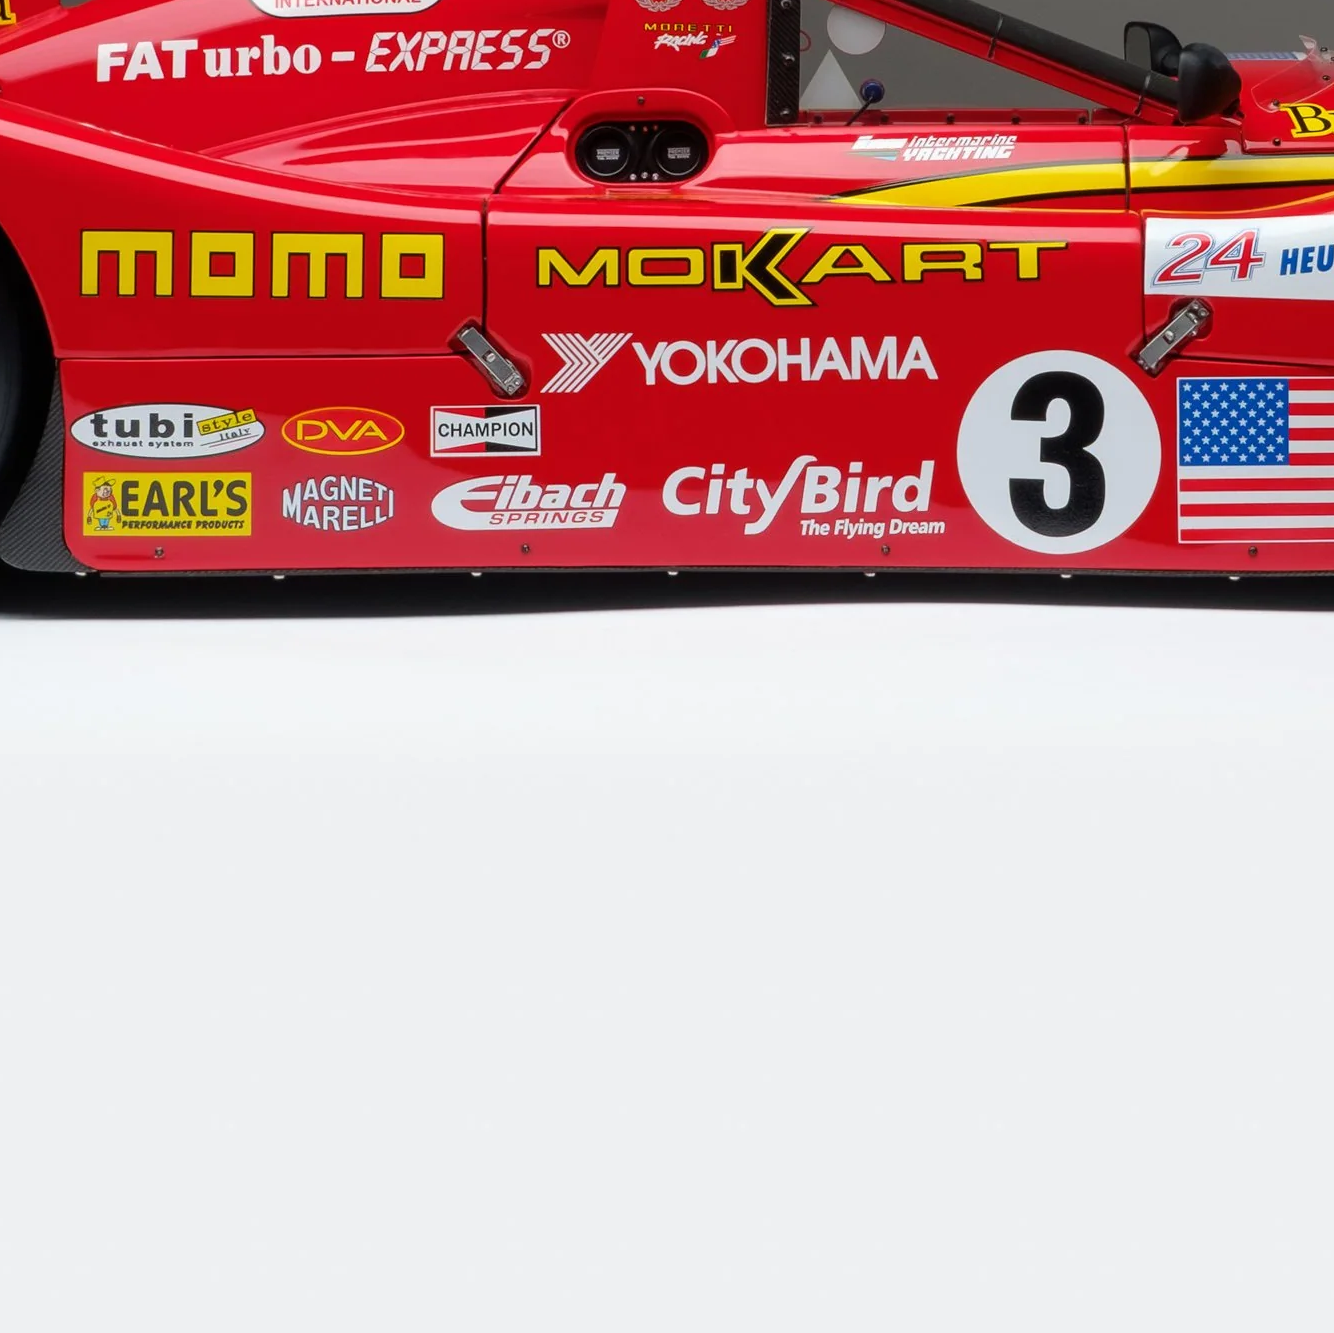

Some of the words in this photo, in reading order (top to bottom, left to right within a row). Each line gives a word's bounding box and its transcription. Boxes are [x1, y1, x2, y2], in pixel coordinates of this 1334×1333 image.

[644, 23, 732, 33] MORETTI
[908, 134, 1017, 148] intermarine
[903, 145, 1015, 162] YACHTING
[536, 226, 1069, 307] MOKART
[1151, 227, 1267, 288] 24
[633, 336, 938, 386] YOKOHAMA
[90, 413, 194, 438] tubi
[201, 411, 253, 435] style
[296, 419, 388, 441] DVA
[438, 421, 534, 439] CHAMPION
[148, 440, 194, 449] system
[1008, 370, 1106, 538] 3
[121, 479, 248, 517] EARL'S
[282, 475, 395, 520] MAGNETI
[431, 473, 627, 518] Eibach
[121, 520, 192, 530] PERFORMANCE
[195, 519, 245, 530] PRODUCTS
[489, 511, 605, 526] SPRINGS
[800, 518, 830, 536] The
[834, 518, 885, 540] Flying
[889, 518, 945, 535] Dream
